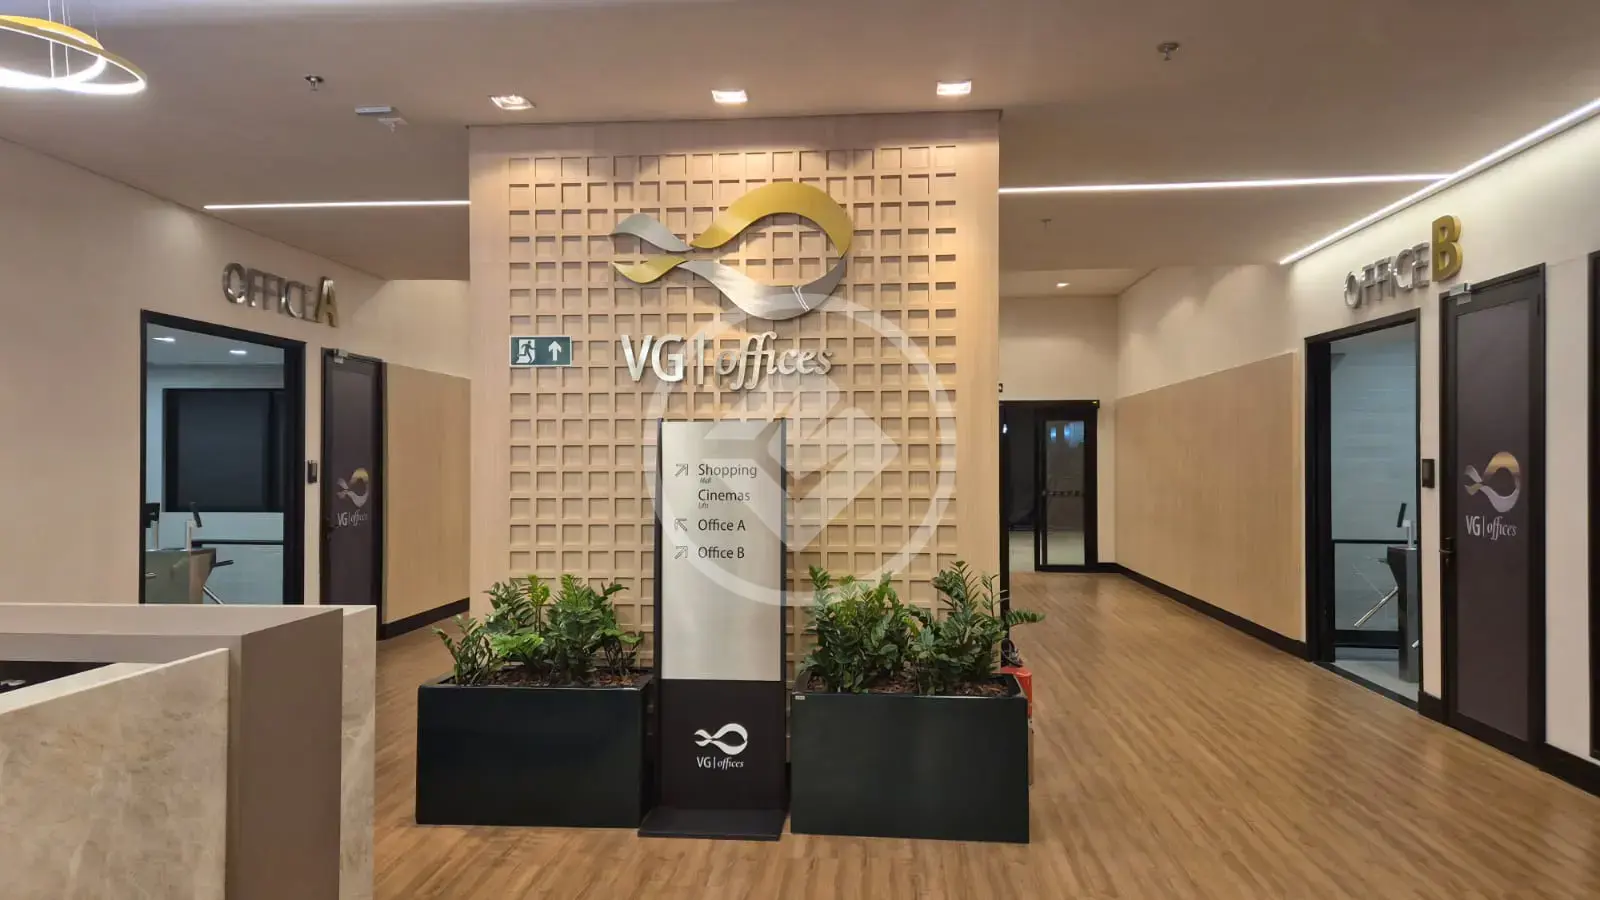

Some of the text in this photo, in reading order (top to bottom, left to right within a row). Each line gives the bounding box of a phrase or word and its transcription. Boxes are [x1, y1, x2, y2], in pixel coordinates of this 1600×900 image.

[716, 330, 833, 391] offices
[698, 463, 758, 479] Shopping
[698, 488, 751, 501] Cinemas
[698, 518, 747, 532] Office A
[1486, 515, 1518, 541] offices
[698, 546, 745, 559] Office B
[717, 756, 744, 771] offices
